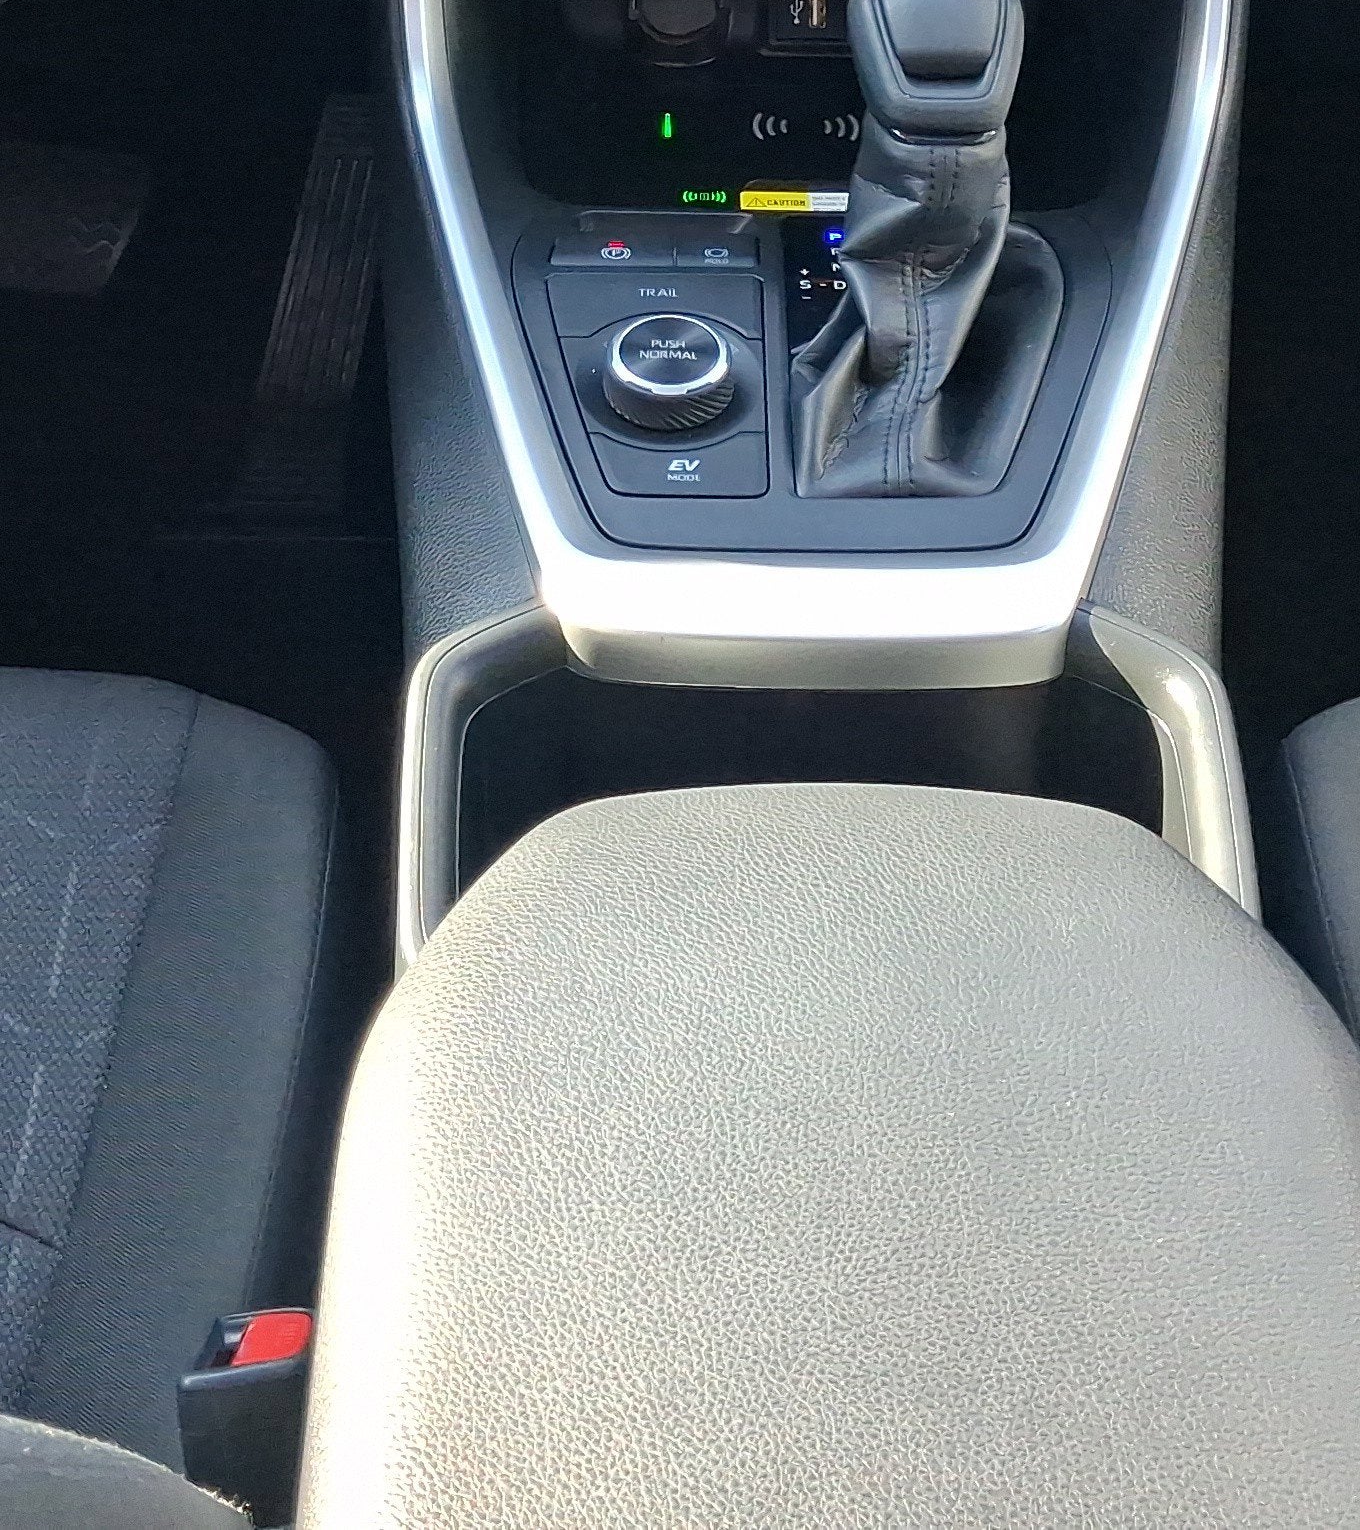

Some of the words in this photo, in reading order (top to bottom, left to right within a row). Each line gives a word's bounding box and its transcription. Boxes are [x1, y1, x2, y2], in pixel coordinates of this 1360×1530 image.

[767, 199, 806, 207] CAUTION
[799, 279, 812, 290] S
[833, 280, 847, 290] D
[638, 288, 679, 298] TRAIL
[651, 339, 686, 349] PUSH
[639, 350, 698, 361] NORMAL
[668, 459, 701, 472] EV
